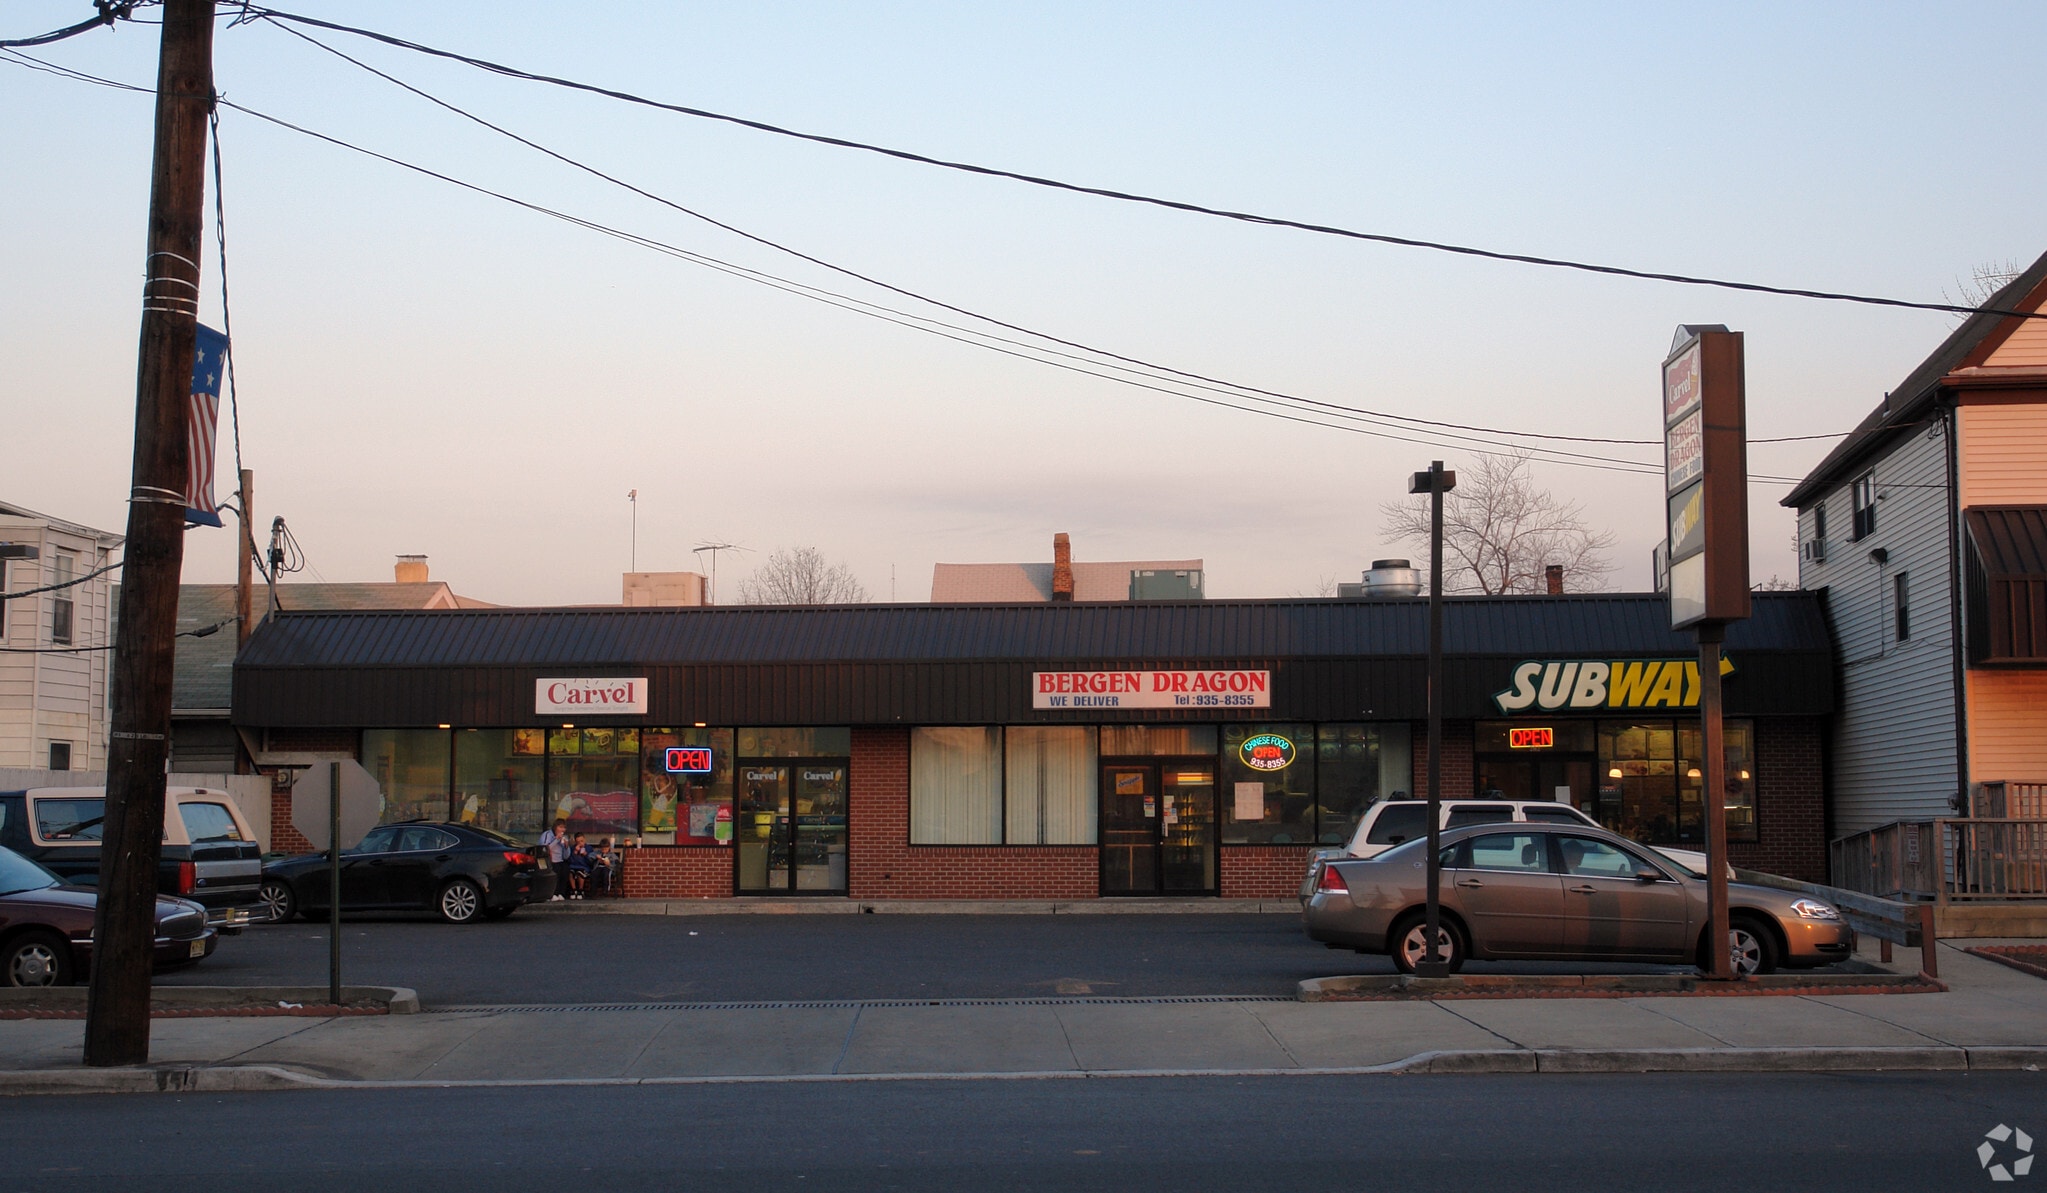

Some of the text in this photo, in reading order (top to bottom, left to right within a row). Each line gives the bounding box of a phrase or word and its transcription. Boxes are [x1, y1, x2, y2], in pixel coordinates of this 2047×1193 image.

[1669, 371, 1691, 404] Carvel
[1670, 413, 1700, 447] BERGEN
[1670, 436, 1701, 470] DRAGON
[1671, 485, 1703, 553] SUBWAY
[1039, 672, 1265, 693] BERGEN DRAGON
[548, 682, 635, 704] Carvel
[1050, 696, 1119, 706] WE DELIVER
[1244, 736, 1289, 751] CHINESE FOOD
[1512, 729, 1551, 746] OPEN
[667, 750, 709, 770] OPEN
[1253, 746, 1281, 758] OPEN
[746, 771, 777, 780] Carvel
[803, 771, 834, 780] Carvel
